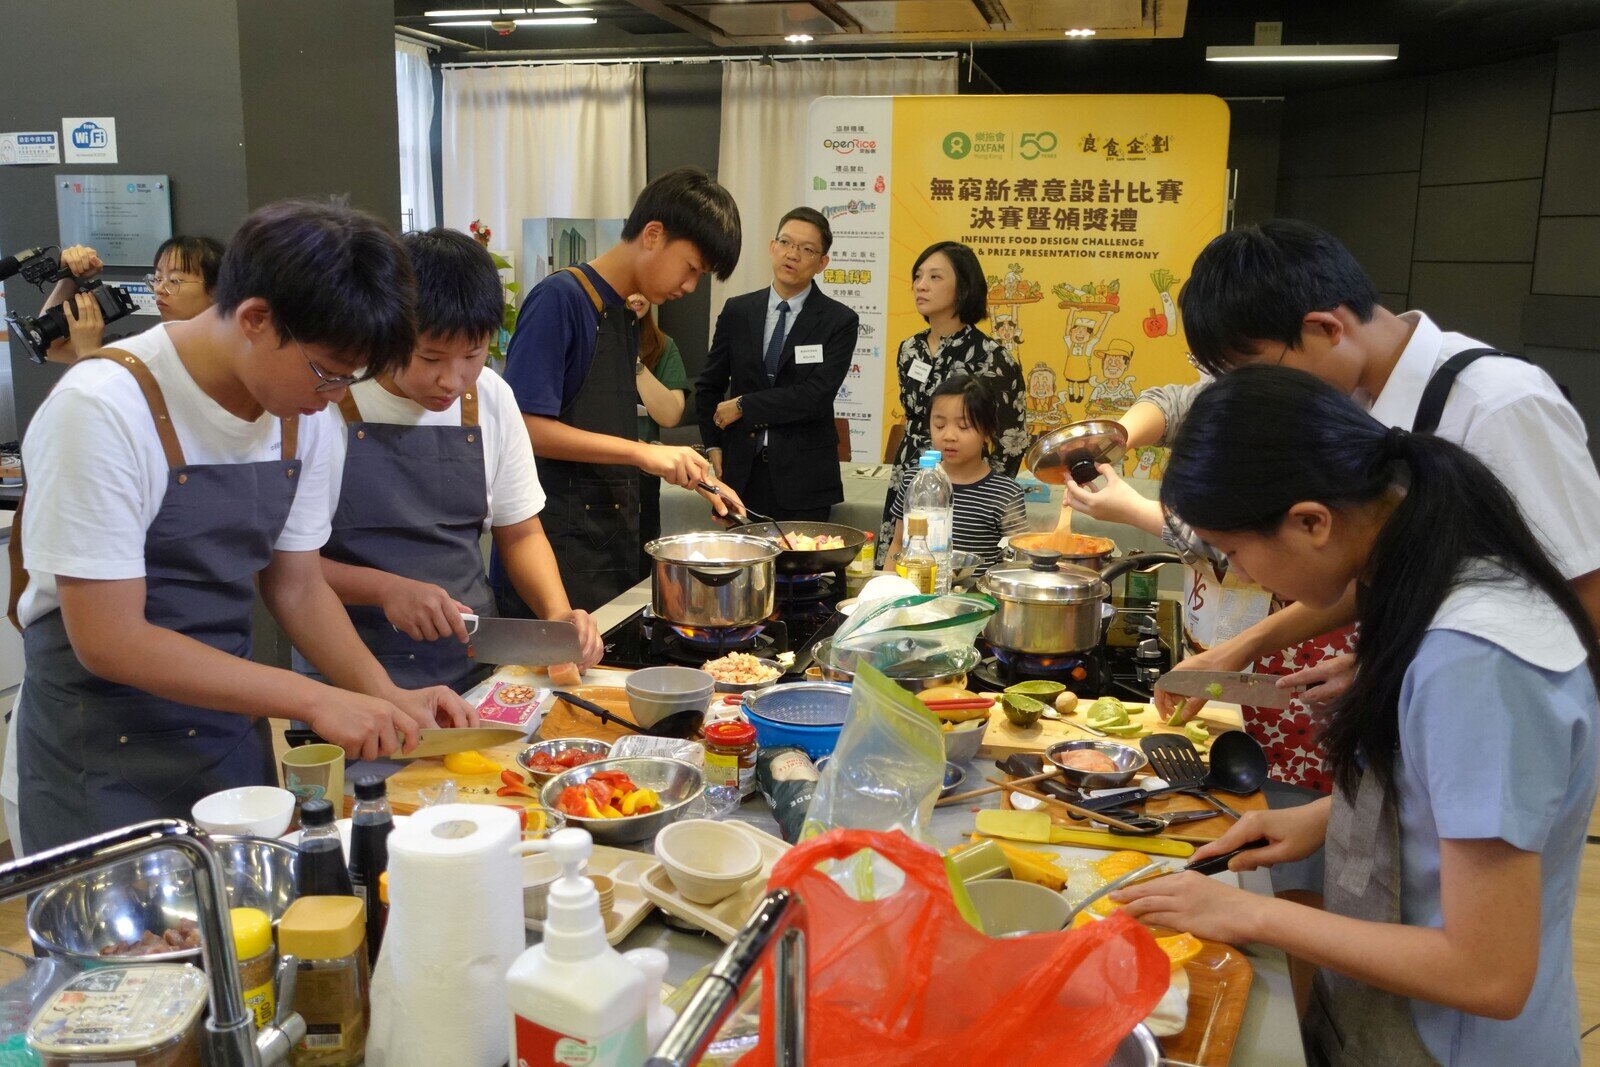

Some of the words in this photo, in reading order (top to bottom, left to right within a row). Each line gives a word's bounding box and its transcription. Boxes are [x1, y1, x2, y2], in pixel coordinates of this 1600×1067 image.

[975, 131, 1006, 142] 樂施會
[824, 139, 876, 150] OpenRice
[974, 143, 1005, 153] OXFAM
[1019, 131, 1058, 161] 50
[1082, 133, 1170, 157] 良食企劃
[929, 177, 1183, 204] 無窮新煮意設計比賽
[969, 206, 1139, 232] 決賽暨頒獎禮
[961, 235, 1006, 244] INFINITE
[1008, 236, 1038, 245] FOOD
[1040, 237, 1079, 246] DESIGN
[1081, 237, 1145, 247] CHALLENGE
[977, 248, 985, 256] &
[987, 248, 1017, 257] PRIZE
[1019, 249, 1096, 258] PRESENTATION
[1099, 250, 1160, 260] CEREMONY
[832, 289, 861, 297] 支持單位
